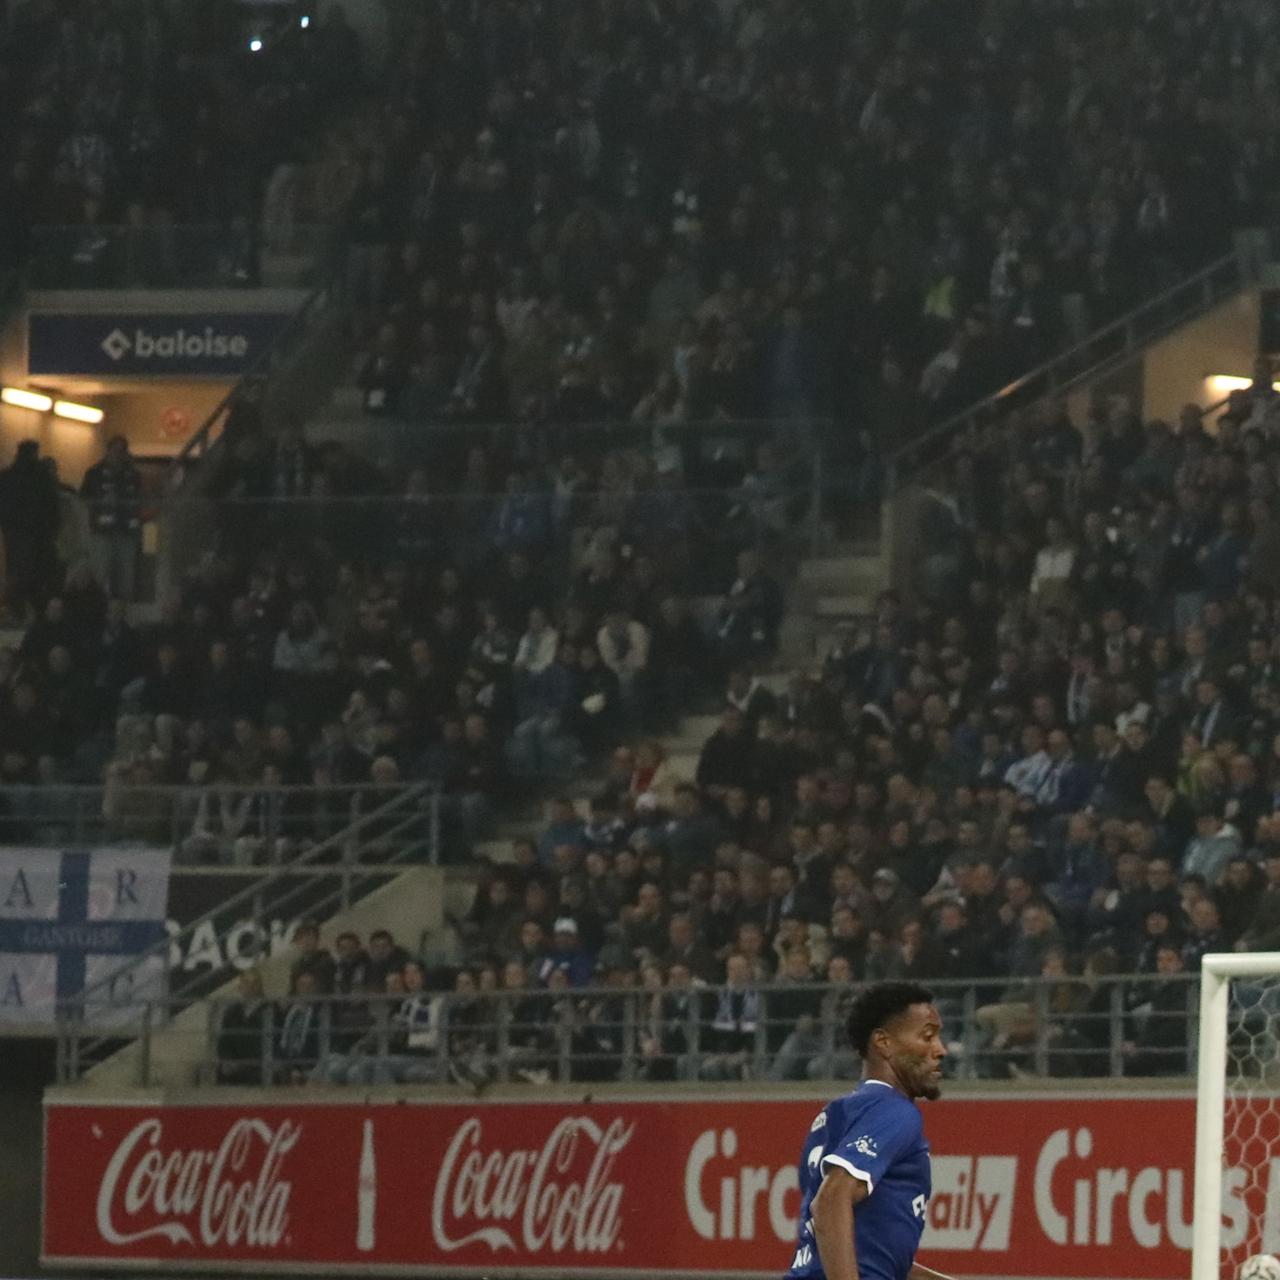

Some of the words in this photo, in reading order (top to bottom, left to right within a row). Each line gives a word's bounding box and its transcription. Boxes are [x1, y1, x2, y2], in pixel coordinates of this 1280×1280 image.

[136, 326, 248, 358] baloise
[8, 866, 33, 906] A
[115, 867, 138, 904] R
[96, 1117, 301, 1247] Coca-Cola
[432, 1114, 635, 1253] Coca-Cola
[685, 1128, 799, 1241] Circ
[927, 1157, 999, 1249] aily
[1033, 1127, 1250, 1249] Circus
